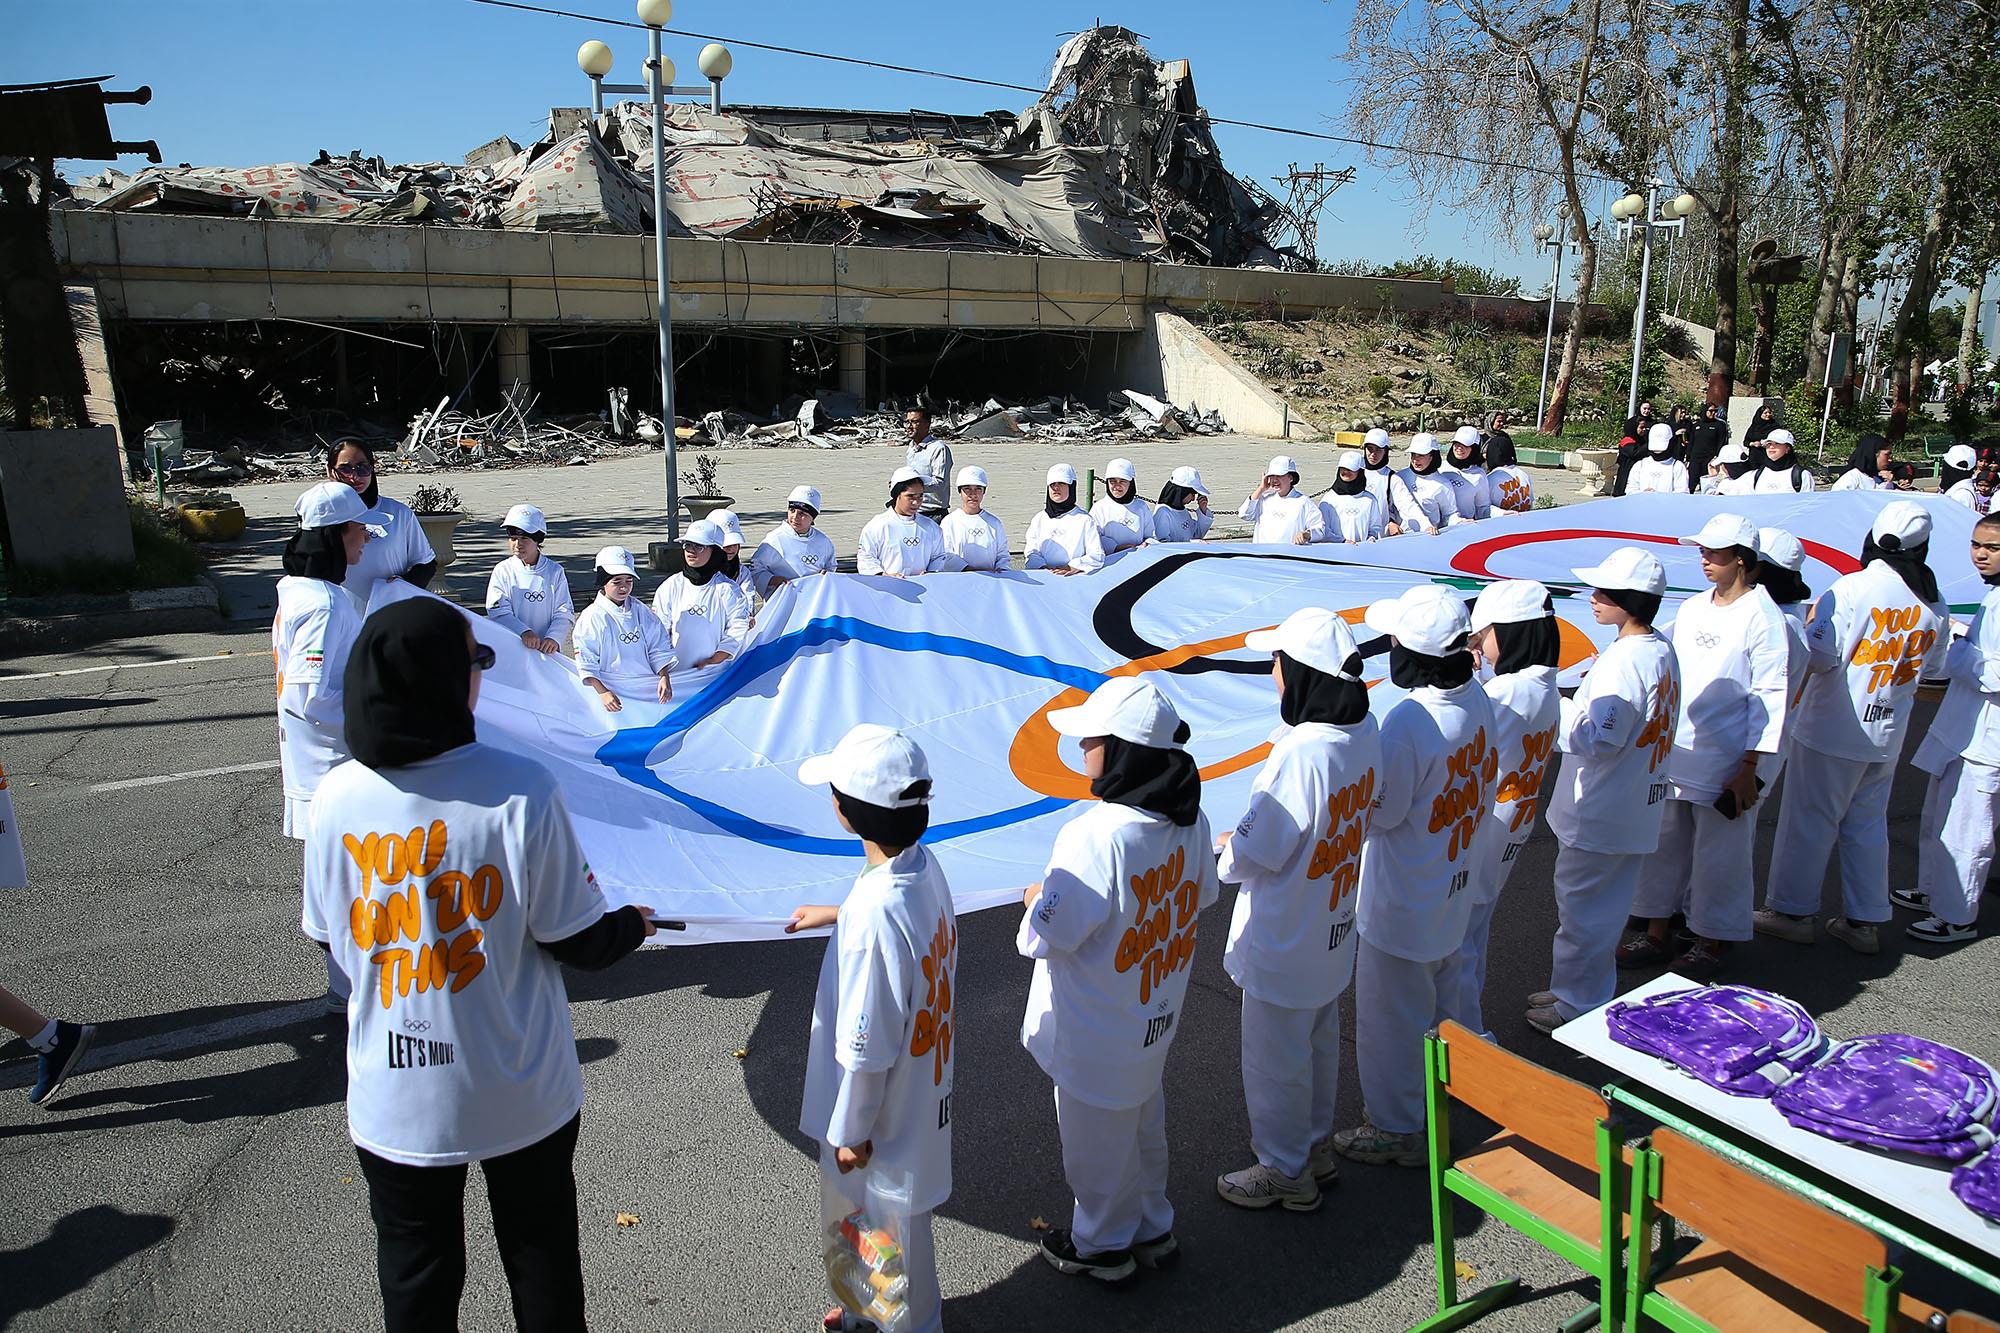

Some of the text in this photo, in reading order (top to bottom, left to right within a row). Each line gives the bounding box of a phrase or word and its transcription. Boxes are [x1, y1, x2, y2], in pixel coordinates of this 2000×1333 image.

[1499, 476, 1520, 498] YOU
[1851, 629, 1936, 666] CAN DO
[1871, 604, 1921, 640] YOU
[1443, 726, 1486, 793] YOU
[1327, 767, 1374, 838] YOU
[1428, 771, 1478, 833] CAN
[342, 819, 448, 899] YOU
[1307, 816, 1362, 880] CAN
[350, 864, 503, 952] CAN DO
[1130, 845, 1185, 926] YOU
[1115, 876, 1200, 974] CAN D
[370, 928, 487, 1010] THIS
[388, 1030, 455, 1068] LET'S MOVE
